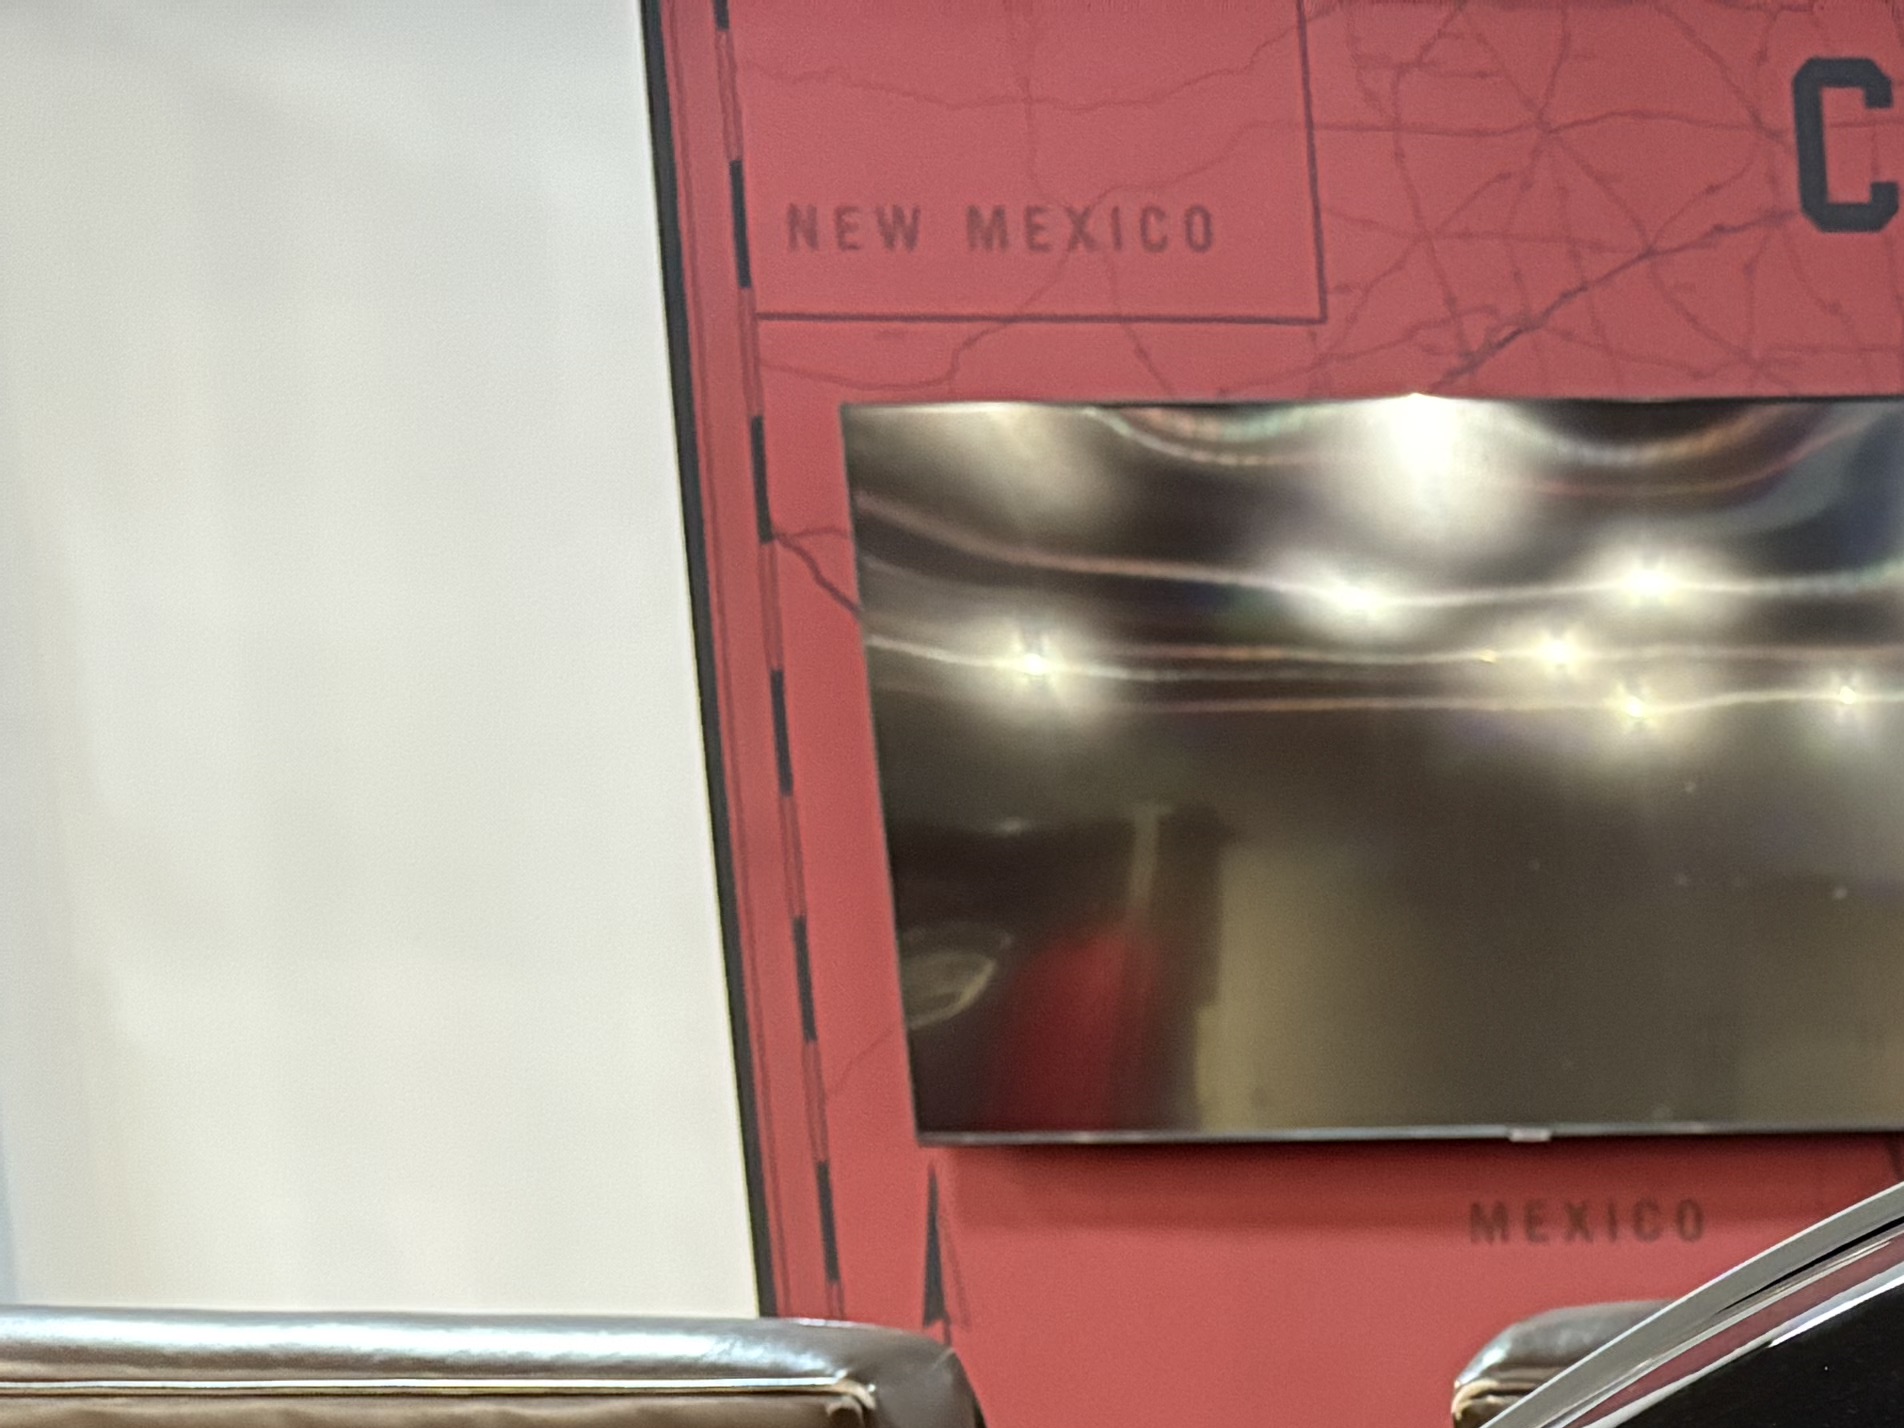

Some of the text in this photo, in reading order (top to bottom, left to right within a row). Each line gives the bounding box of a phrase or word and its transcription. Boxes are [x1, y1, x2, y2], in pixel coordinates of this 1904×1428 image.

[787, 203, 1219, 256] NEW MEXICO
[1467, 1196, 1708, 1247] MEXICO
